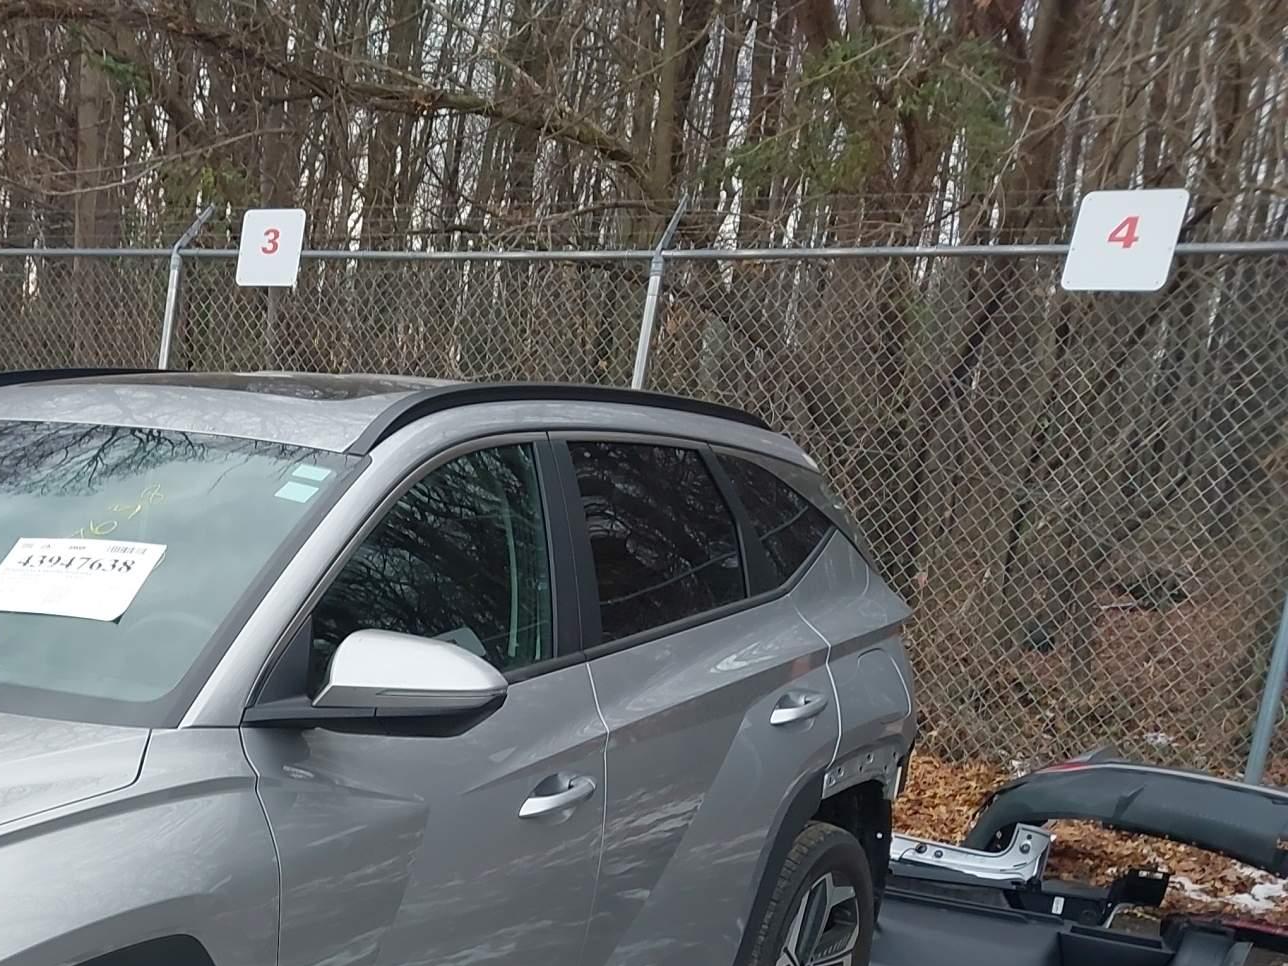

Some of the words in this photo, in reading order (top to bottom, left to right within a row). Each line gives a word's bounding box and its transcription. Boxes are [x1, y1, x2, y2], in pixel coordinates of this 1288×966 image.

[261, 228, 280, 255] 3
[1107, 215, 1140, 249] 4
[17, 554, 136, 574] 43947638
